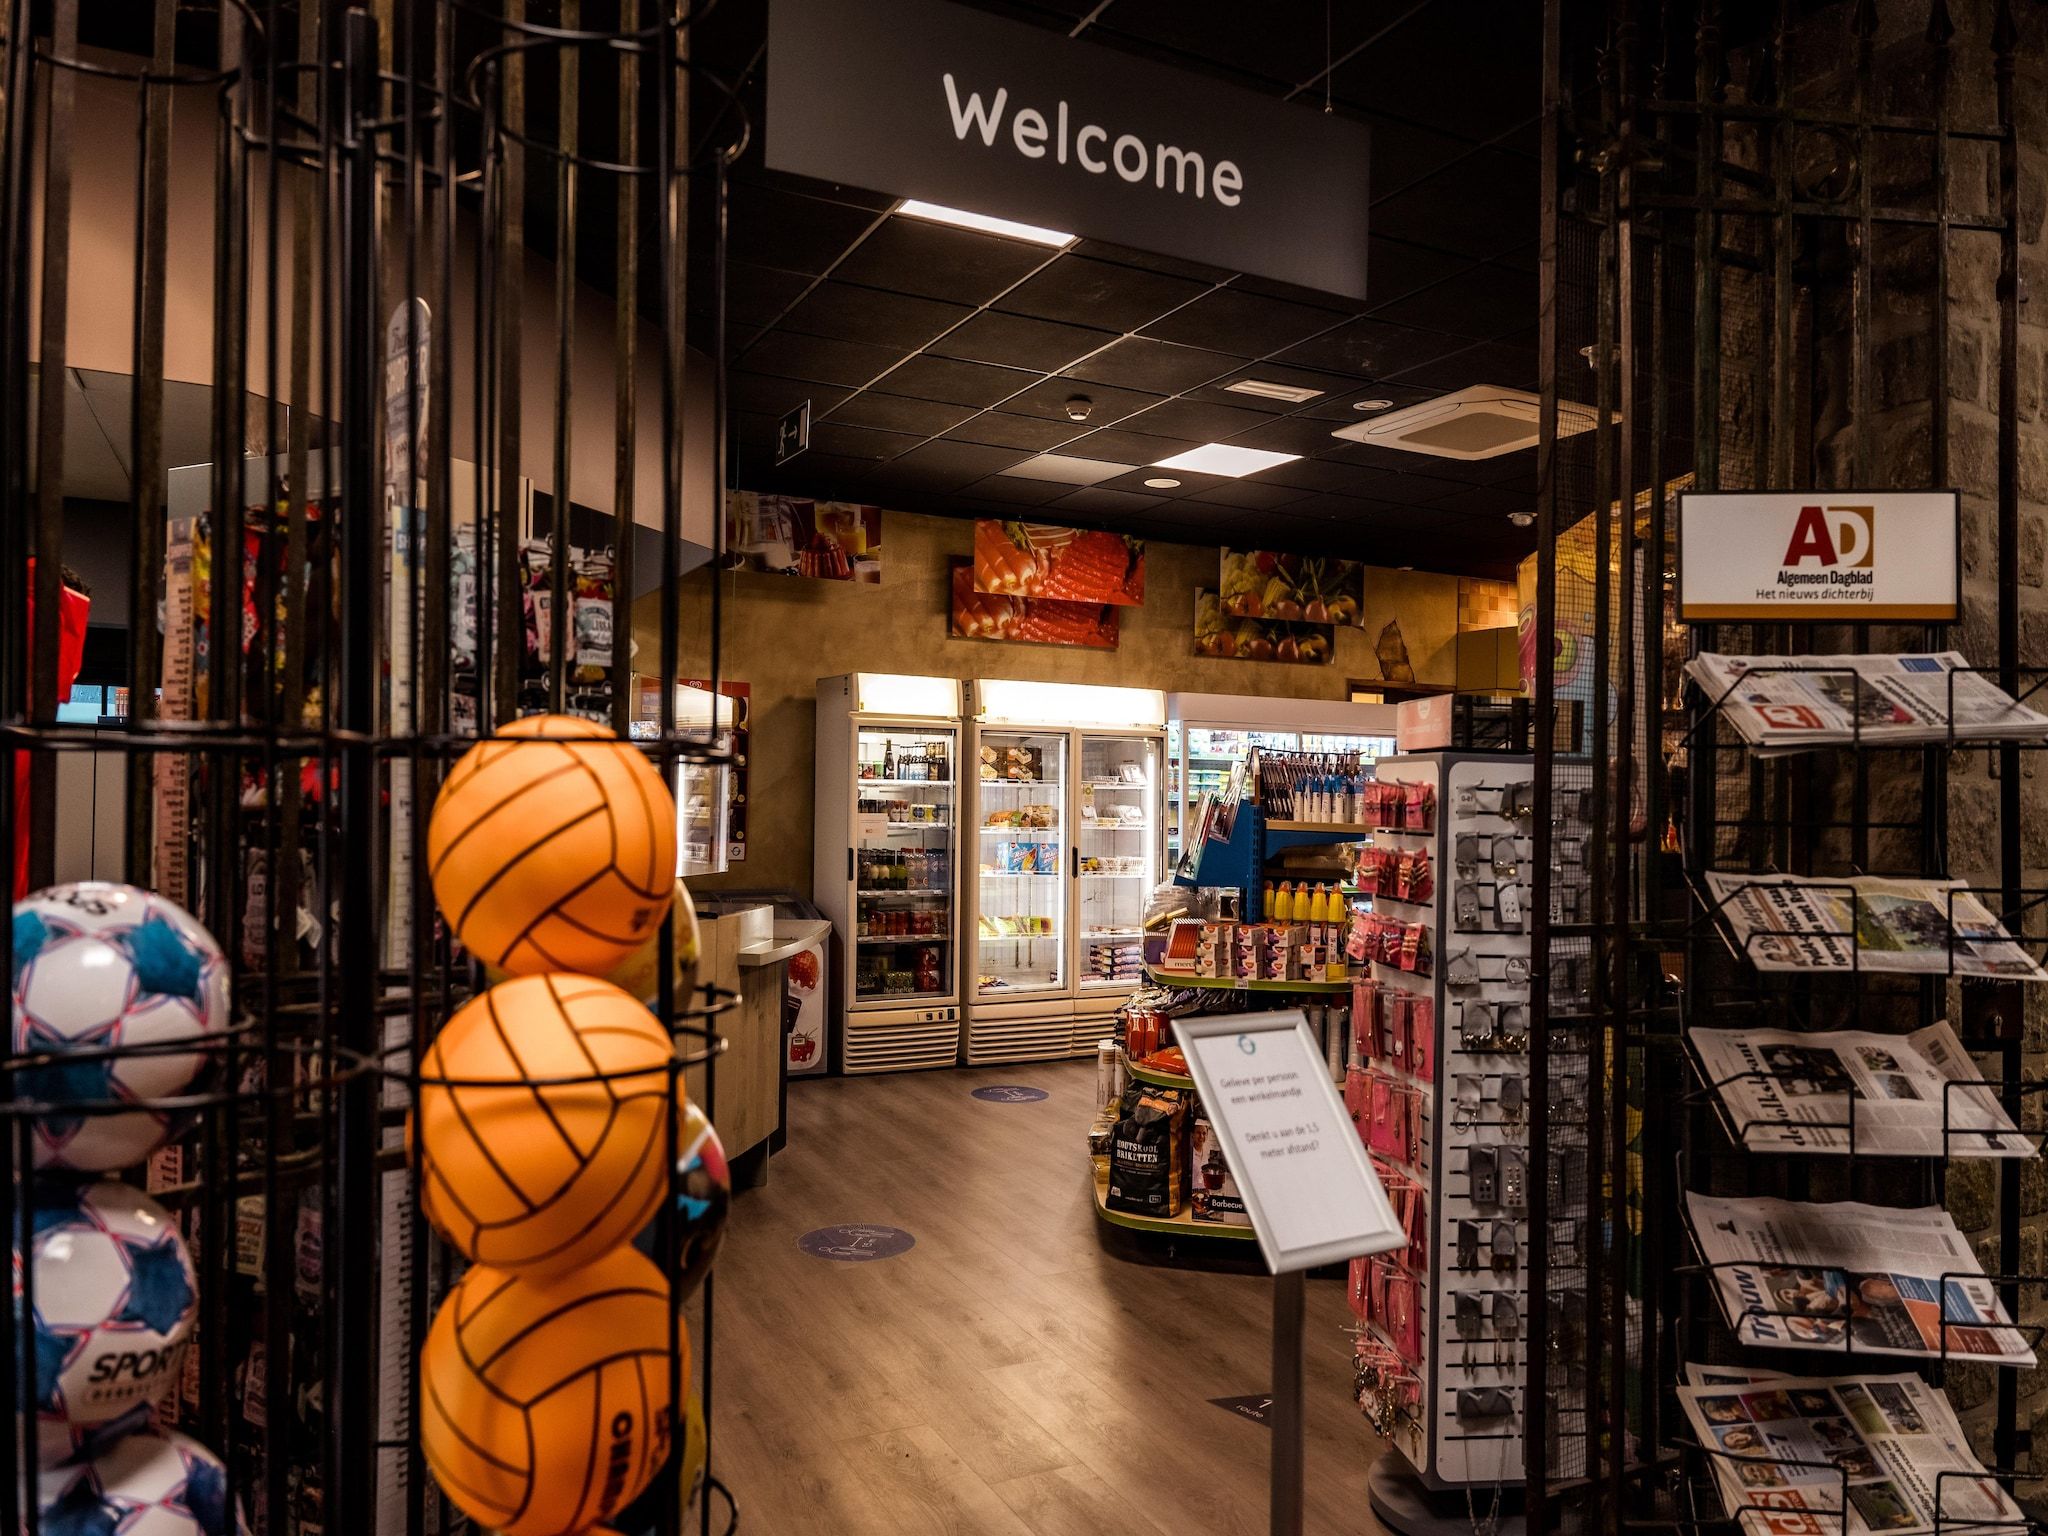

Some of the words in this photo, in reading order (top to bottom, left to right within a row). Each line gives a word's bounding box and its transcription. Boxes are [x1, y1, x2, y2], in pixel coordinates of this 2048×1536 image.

[943, 73, 1243, 207] Welcome
[1783, 506, 1874, 567] AD
[1777, 570, 1828, 587] Algemeen
[1830, 570, 1873, 587] Dagblad
[1756, 589, 1776, 599] Het
[1779, 588, 1819, 599] nieuws
[1821, 588, 1874, 602] dichterbij
[1797, 904, 1819, 923] met
[1220, 1077, 1251, 1089] Gelieve
[1252, 1074, 1266, 1086] per
[1249, 1086, 1303, 1102] winkelmandje
[1245, 1130, 1272, 1144] Denkt
[1280, 1128, 1295, 1139] aan
[1295, 1125, 1306, 1136] de
[1116, 1139, 1159, 1154] HOUTSKOOL
[1260, 1147, 1286, 1160] meter
[1287, 1140, 1321, 1156] afstand?
[1116, 1149, 1159, 1163] BRIKETTEN
[1211, 1199, 1244, 1210] Barbecue
[1732, 1268, 1778, 1339] Trouw
[1236, 1404, 1264, 1419] route
